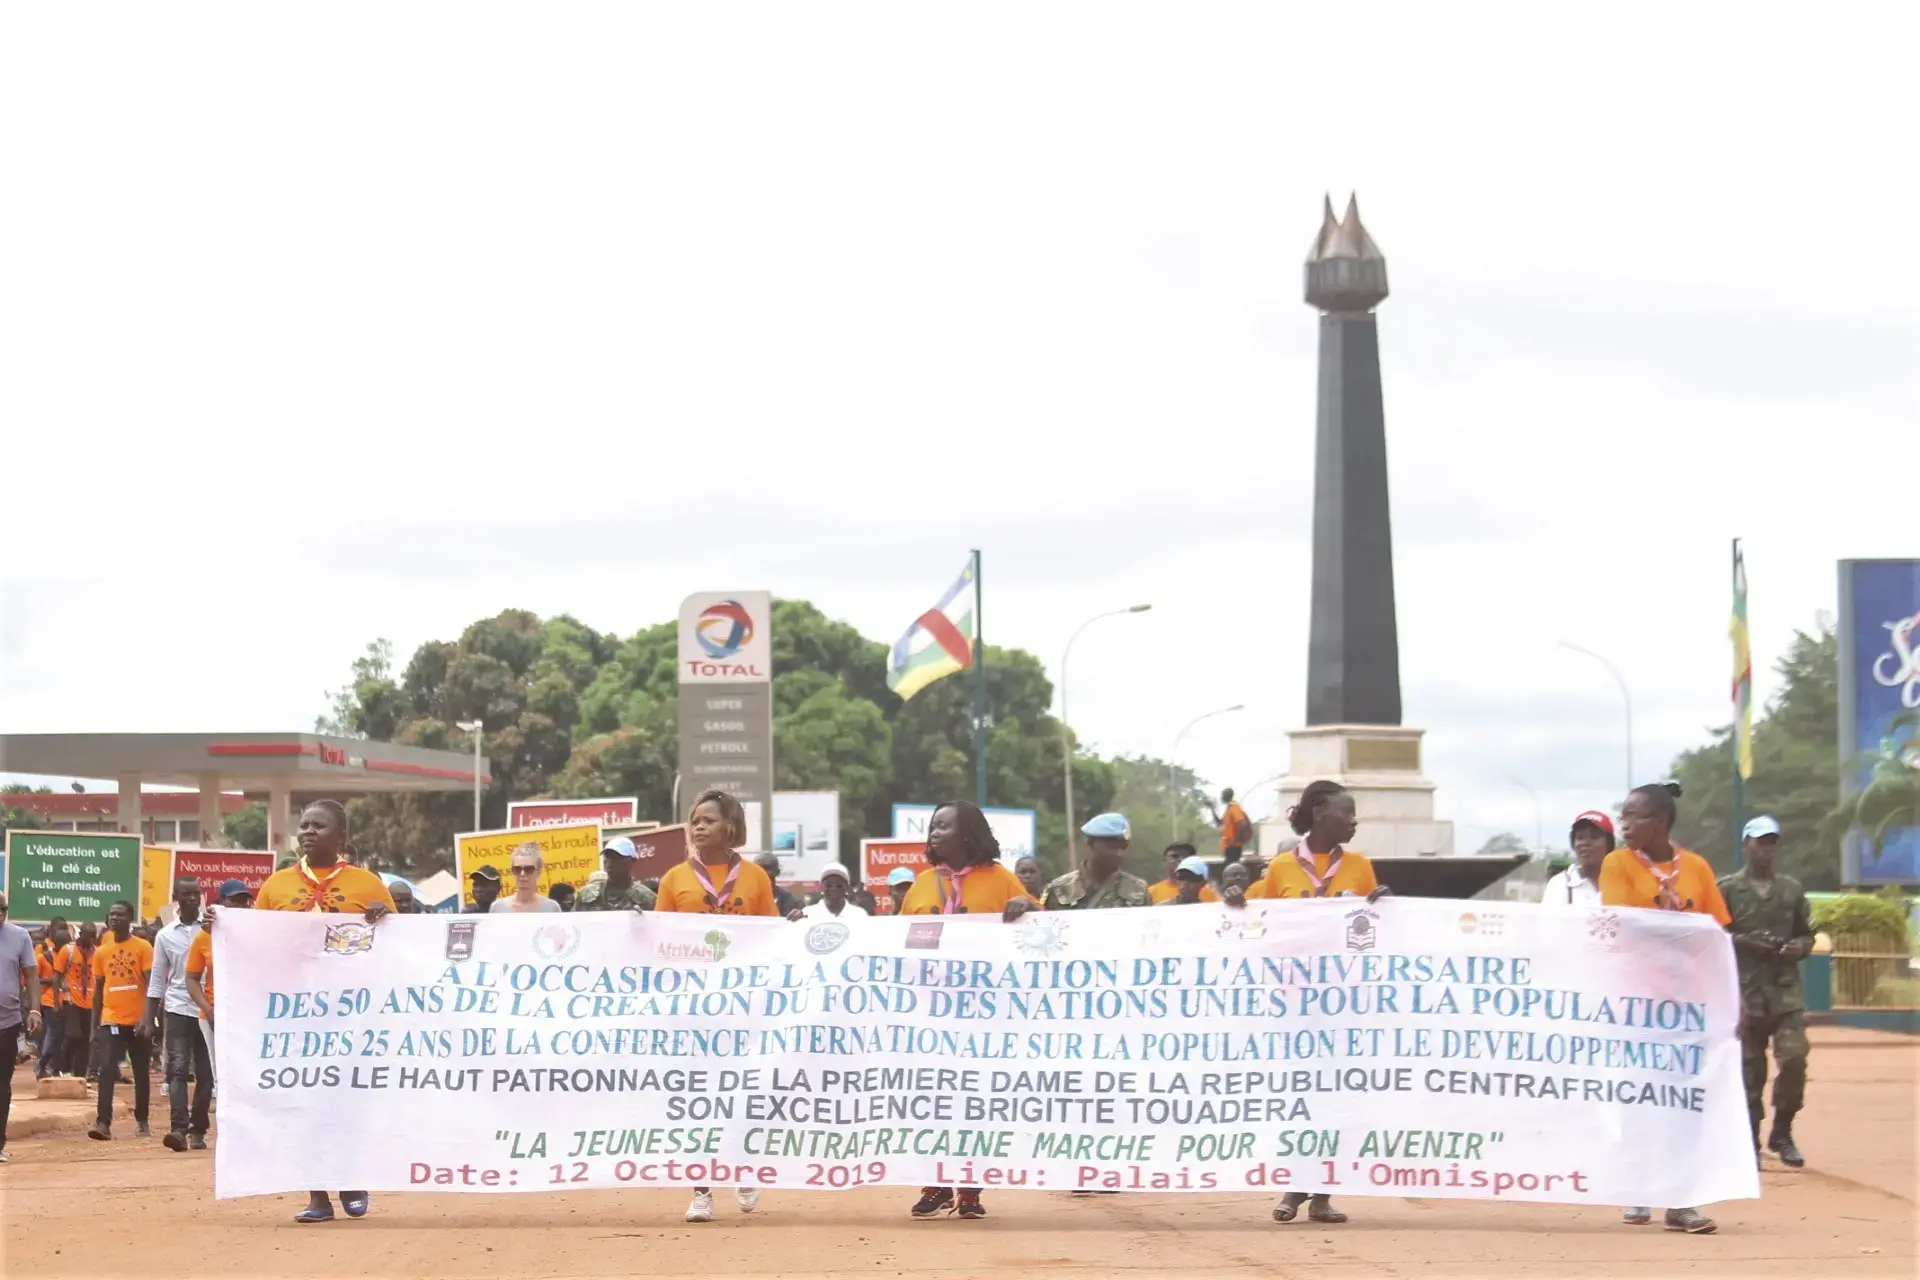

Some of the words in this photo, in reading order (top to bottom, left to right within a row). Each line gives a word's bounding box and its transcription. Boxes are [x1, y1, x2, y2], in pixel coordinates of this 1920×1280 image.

[687, 661, 763, 677] TOTAL
[700, 743, 749, 753] PETROLE
[26, 844, 96, 858] L'éducation
[101, 848, 120, 859] est
[467, 844, 503, 858] Nous
[564, 832, 598, 848] route
[871, 848, 897, 865] Non
[898, 852, 919, 865] aux
[42, 862, 54, 874] la
[62, 862, 80, 874] clé
[85, 864, 101, 875] de
[180, 860, 201, 872] Non
[203, 862, 220, 873] aux
[221, 861, 254, 874] besoins
[255, 865, 271, 875] non
[22, 878, 121, 893] l'autonomisation
[38, 895, 72, 907] d'une
[78, 896, 100, 908] fille
[437, 961, 463, 985] A
[475, 961, 707, 994] L'OCCASION
[720, 965, 770, 990] DE
[781, 961, 828, 989] LA
[840, 955, 1118, 989] CELEBRATION
[1131, 957, 1182, 987] DE
[1194, 955, 1531, 987] L'ANNIVERSAIRE
[265, 991, 330, 1020] DES
[337, 988, 371, 1017] 50
[379, 985, 444, 1014] ANS
[452, 987, 500, 1014] DE
[510, 992, 556, 1018] LA
[567, 990, 752, 1020] CREATION
[762, 988, 809, 1017] DU
[822, 985, 917, 1015] FOND
[928, 990, 997, 1020] DES
[1006, 989, 1168, 1020] NATIONS
[1180, 988, 1287, 1019] UNIES
[1297, 984, 1399, 1017] POUR
[1411, 984, 1460, 1014] LA
[1471, 987, 1706, 1032] POPULATION
[258, 1032, 297, 1059] ET
[300, 1030, 353, 1058] DES
[361, 1029, 389, 1057] 25
[397, 1030, 452, 1058] ANS
[462, 1027, 497, 1058] DE
[506, 1028, 541, 1056] LA
[551, 1029, 750, 1058] CONFERENCE
[758, 1024, 1018, 1060] INTERNATIONALE
[1026, 1032, 1083, 1060] SUR
[1092, 1032, 1131, 1060] LA
[1140, 1029, 1336, 1062] POPULATION
[1345, 1028, 1384, 1057] ET
[1394, 1028, 1432, 1058] LE
[1440, 1029, 1705, 1076] DEVELOPPEMENT
[257, 1065, 340, 1089] SOUS
[351, 1066, 389, 1089] LE
[399, 1067, 484, 1092] HAUT
[492, 1068, 707, 1093] PATRONNAGE
[718, 1069, 761, 1092] DE
[772, 1067, 812, 1092] LA
[822, 1067, 980, 1094] PREMIERE
[991, 1070, 1083, 1093] DAME
[1094, 1071, 1137, 1094] DE
[1149, 1072, 1191, 1095] LA
[1200, 1067, 1412, 1096] REPUBLIQUE
[1424, 1068, 1706, 1112] CENTRAFRICAINE
[665, 1095, 734, 1121] SON
[745, 1094, 953, 1125] EXCELLENCE
[964, 1096, 1115, 1123] BRIGITTE
[1126, 1097, 1312, 1125] TOUADERA
[495, 1130, 547, 1159] "LA
[567, 1127, 724, 1157] JEUNESSE
[743, 1127, 1014, 1160] CENTRAFRICAINE
[1032, 1132, 1155, 1161] MARCHE
[1176, 1132, 1256, 1162] POUR
[1276, 1129, 1340, 1158] SON
[1358, 1130, 1504, 1160] AVENIR"
[409, 1162, 519, 1187] Date:
[549, 1161, 589, 1184] 12
[614, 1159, 778, 1184] Octobre
[805, 1161, 887, 1188] 2019
[936, 1161, 1046, 1187] Lieu:
[1077, 1165, 1218, 1189] Palais
[1244, 1162, 1292, 1187] de
[1320, 1161, 1589, 1195] l'Omnisport
